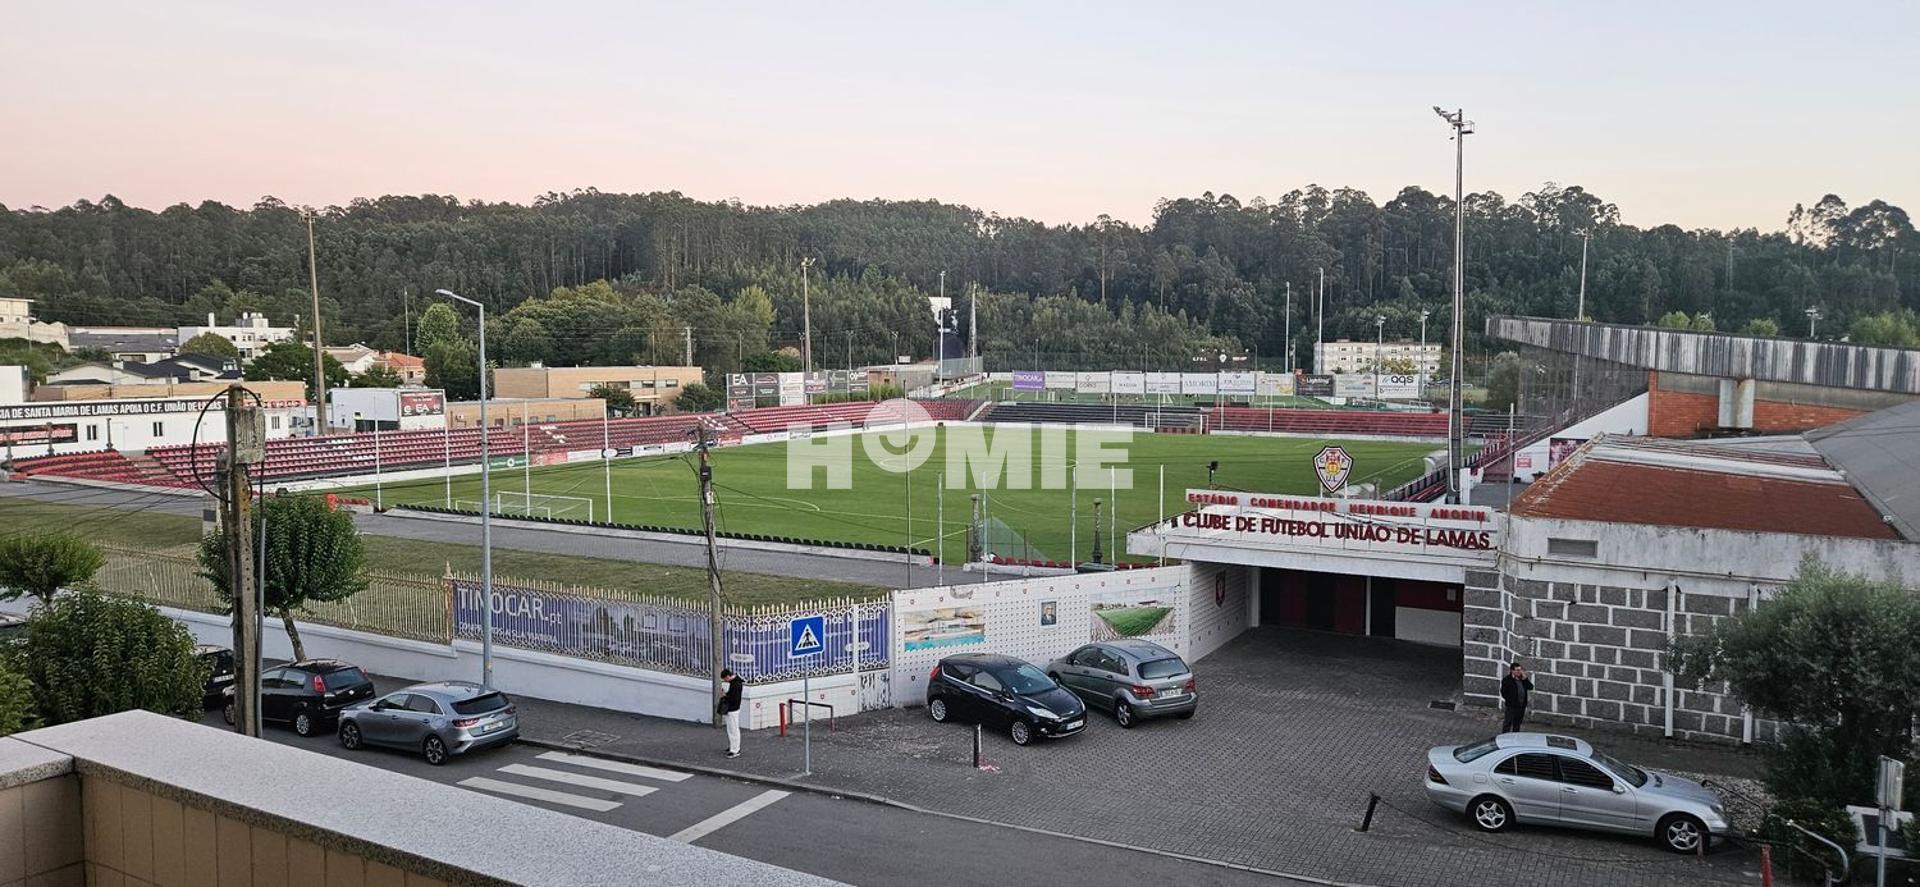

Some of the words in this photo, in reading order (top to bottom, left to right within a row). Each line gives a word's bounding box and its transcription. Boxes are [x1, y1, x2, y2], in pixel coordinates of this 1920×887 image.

[12, 408, 23, 419] DE
[24, 407, 51, 418] SANTA
[53, 406, 79, 417] MARIA
[80, 405, 91, 416] DE
[92, 404, 118, 415] LAMAS
[120, 403, 142, 414] APOIA
[143, 403, 149, 413] O
[1188, 492, 1238, 506] ESTÁDIO
[1250, 497, 1336, 512] COMENDADOR
[1350, 503, 1416, 517] HENRIQUE
[1430, 508, 1486, 522] AMORIM
[1183, 511, 1231, 531] CLUBE
[1235, 516, 1257, 533] DE
[1261, 517, 1330, 539] FUTEBOL
[1334, 520, 1391, 543] UNIÃO
[1397, 526, 1421, 546] DE
[1426, 528, 1490, 550] LAMAS
